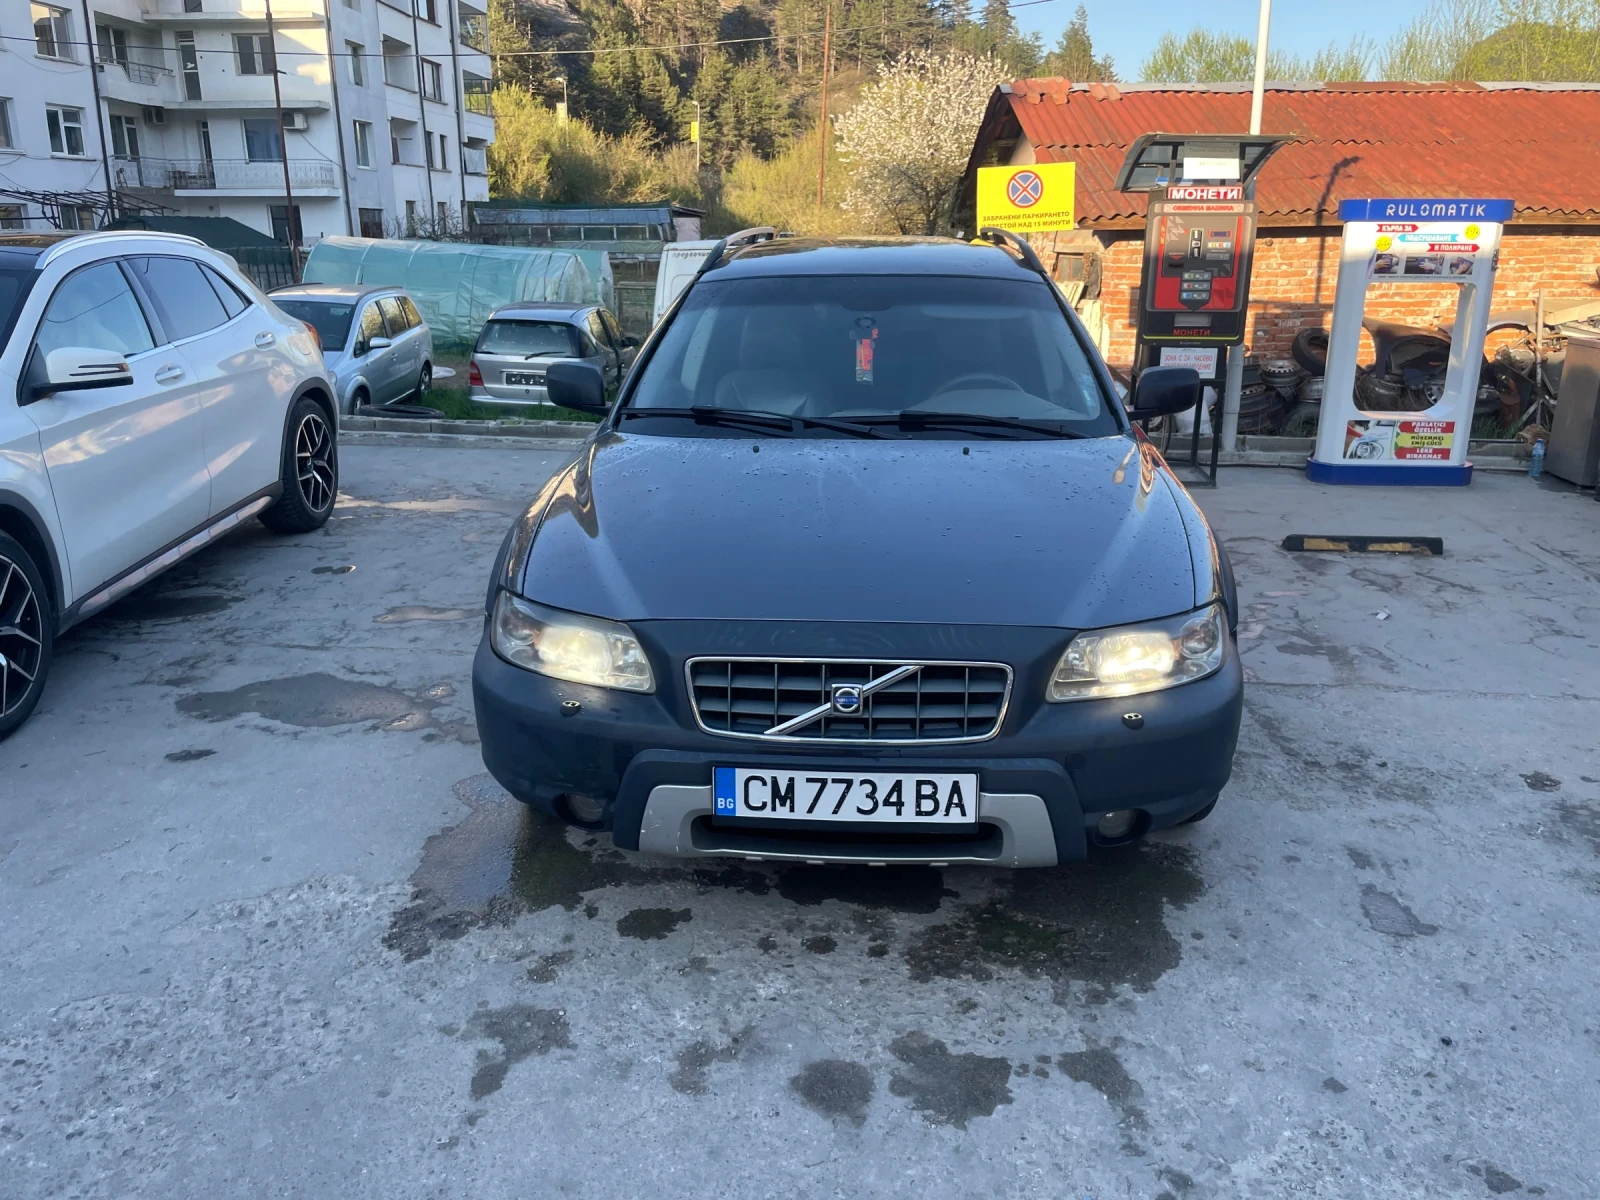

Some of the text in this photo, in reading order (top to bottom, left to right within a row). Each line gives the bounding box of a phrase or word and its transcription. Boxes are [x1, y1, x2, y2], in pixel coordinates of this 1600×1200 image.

[1171, 189, 1238, 200] МОНЕТИ
[982, 211, 1070, 222] ЗАБРАНЕНИ ПАРКИРАНЕТО
[1042, 219, 1071, 227] МИНУТИ
[1193, 354, 1213, 362] ЧАСОВО
[717, 797, 734, 809] BG
